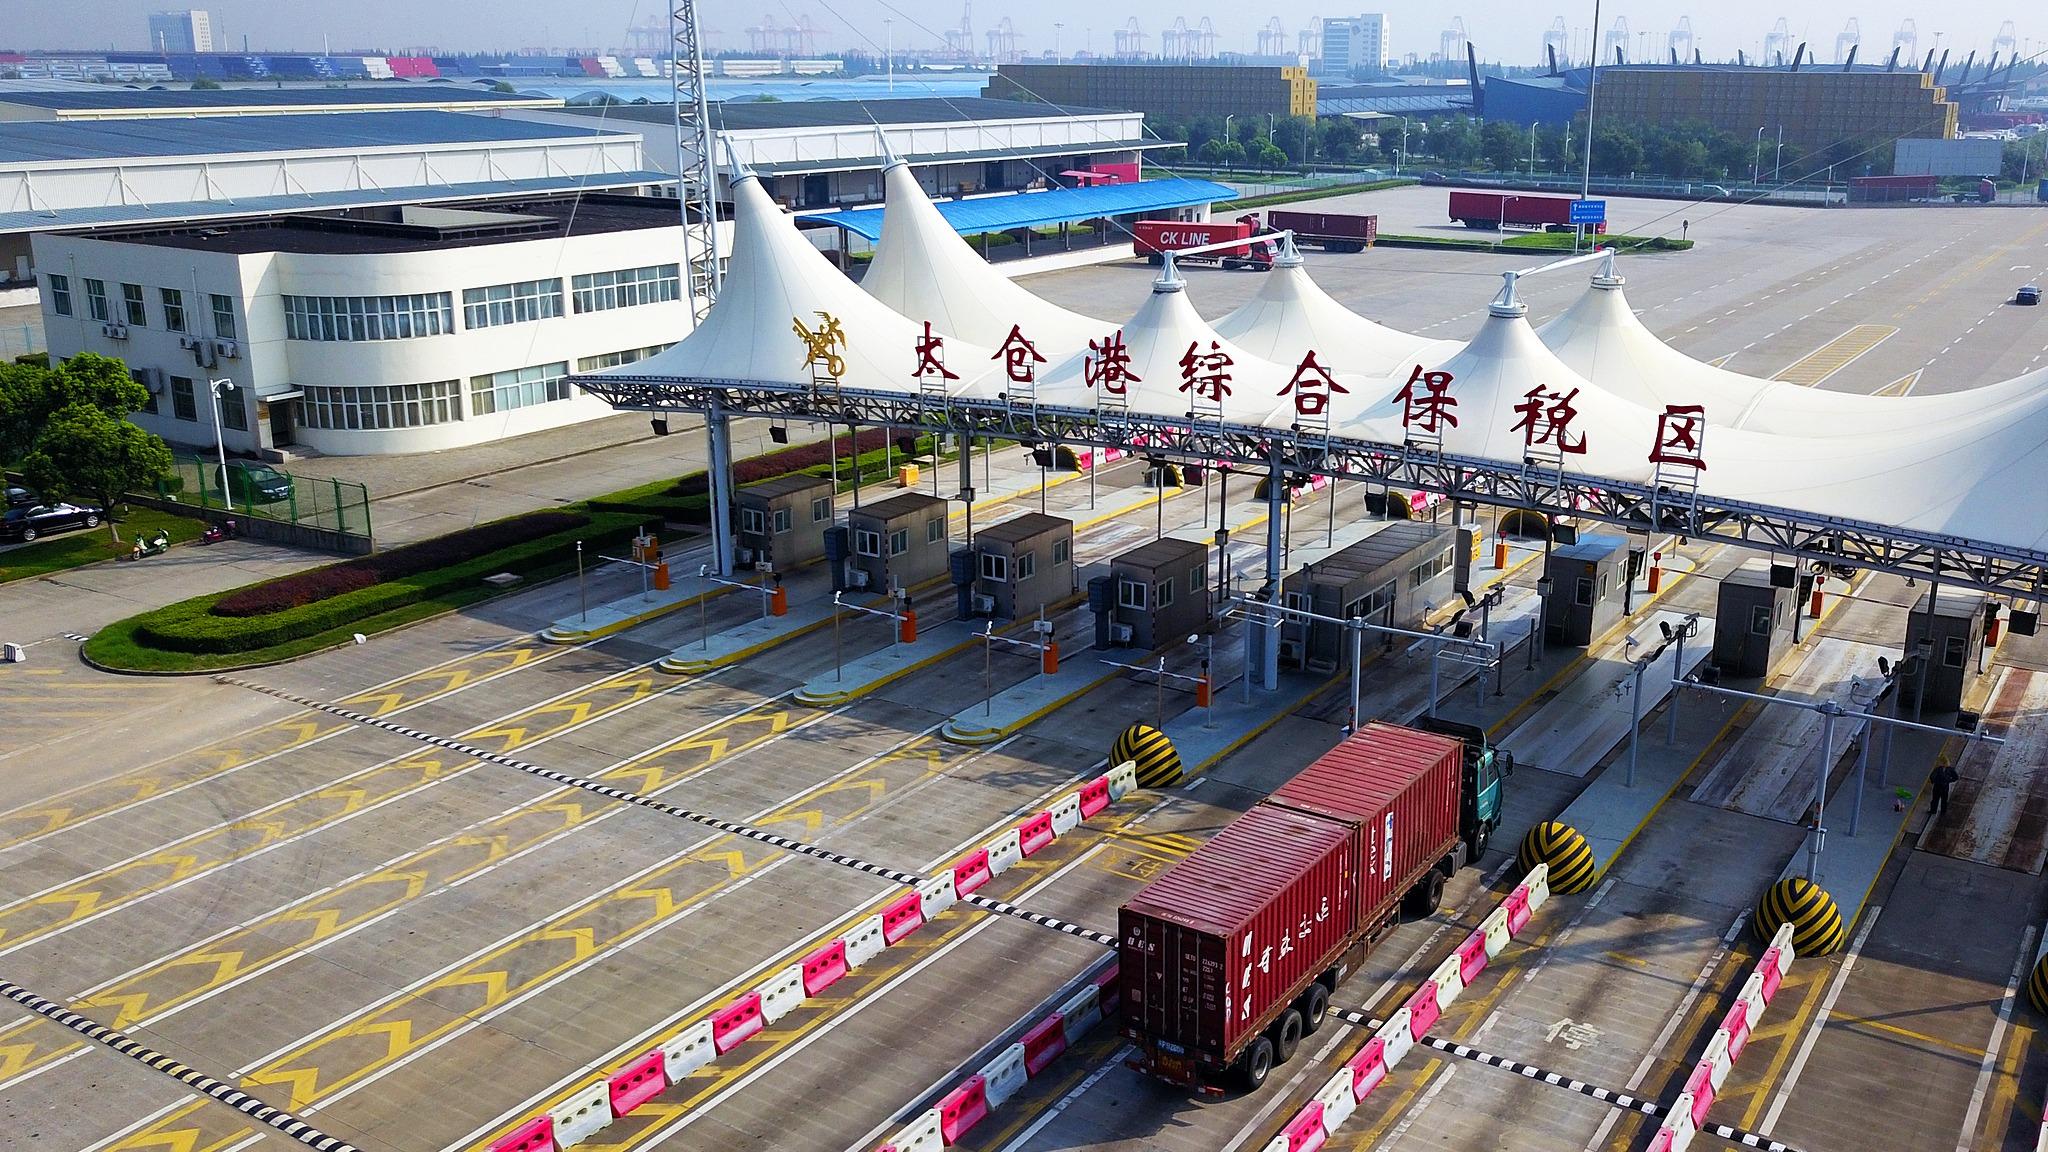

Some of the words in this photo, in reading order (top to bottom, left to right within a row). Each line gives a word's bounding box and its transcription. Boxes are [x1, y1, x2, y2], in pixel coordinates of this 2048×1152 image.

[1160, 231, 1178, 245] CK
[1181, 232, 1210, 246] LINE
[911, 320, 1707, 471] 太仓港综合保税区
